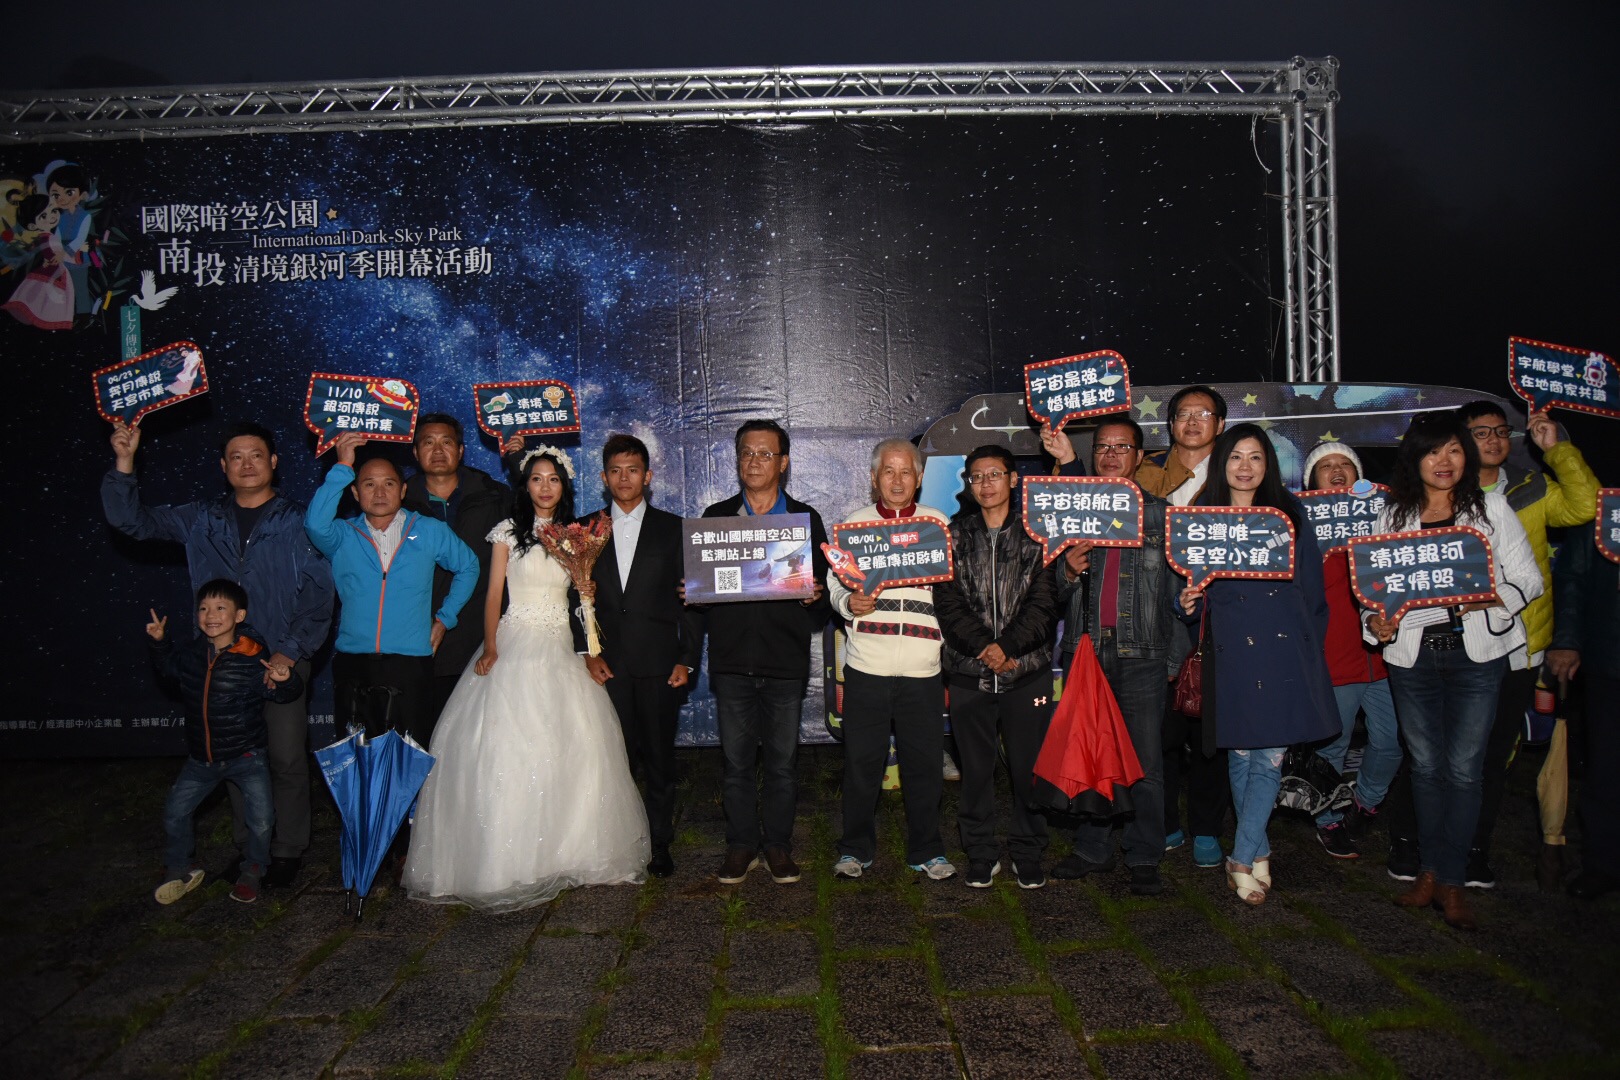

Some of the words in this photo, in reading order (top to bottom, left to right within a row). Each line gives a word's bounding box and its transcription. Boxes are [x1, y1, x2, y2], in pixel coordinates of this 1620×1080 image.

[141, 199, 318, 235] 國際暗空公園
[252, 231, 347, 250] International
[352, 228, 424, 247] Dark-Sky
[429, 227, 462, 243] Park
[107, 370, 133, 385] 09/23
[1517, 356, 1575, 378] 宇航學堂
[108, 370, 162, 399] 奔月傳說
[1030, 367, 1098, 394] 宇宙最強
[1520, 374, 1607, 402] 在地商家共識
[111, 383, 165, 412] 天宮市集
[327, 386, 363, 399] 11/10
[1046, 385, 1115, 413] 婚攝基地
[323, 399, 381, 416] 銀河傳說
[517, 397, 543, 410] 清境
[486, 409, 568, 427] 友善星空商店
[1033, 492, 1131, 513] 宇宙領航員
[690, 527, 806, 545] 合歡山國際暗空公園
[1061, 516, 1102, 536] 在此
[1187, 522, 1270, 542] 台灣唯一
[848, 534, 875, 545] 08/04
[863, 543, 890, 554] 11/10
[701, 547, 766, 563] 監測站上線
[857, 549, 945, 571] 星艦傳說啟動
[1187, 546, 1270, 567] 星空小鎮
[1370, 541, 1464, 569] 清境銀河
[1385, 569, 1455, 594] 定情照
